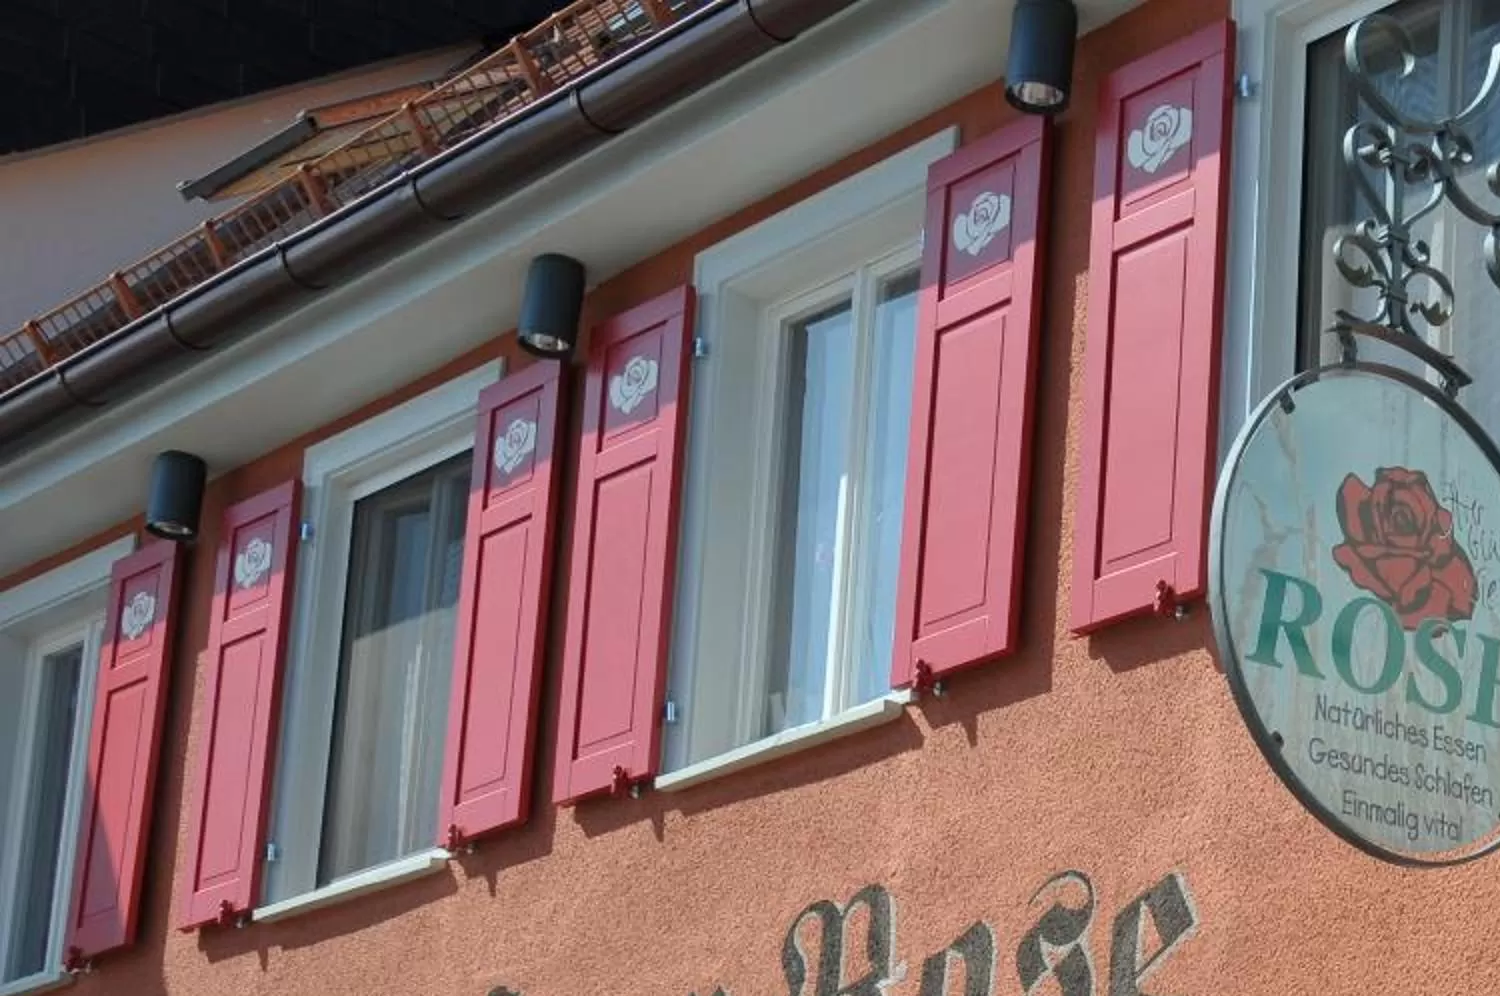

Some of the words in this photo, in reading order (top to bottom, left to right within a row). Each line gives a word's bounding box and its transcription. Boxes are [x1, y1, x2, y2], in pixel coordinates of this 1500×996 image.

[1314, 692, 1429, 748] Natürliches
[1432, 724, 1488, 765] Essen
[1308, 736, 1410, 786] Gesundes
[1415, 762, 1493, 808] Schlafen
[1341, 788, 1420, 841] Einmalig
[1423, 812, 1464, 841] vital
